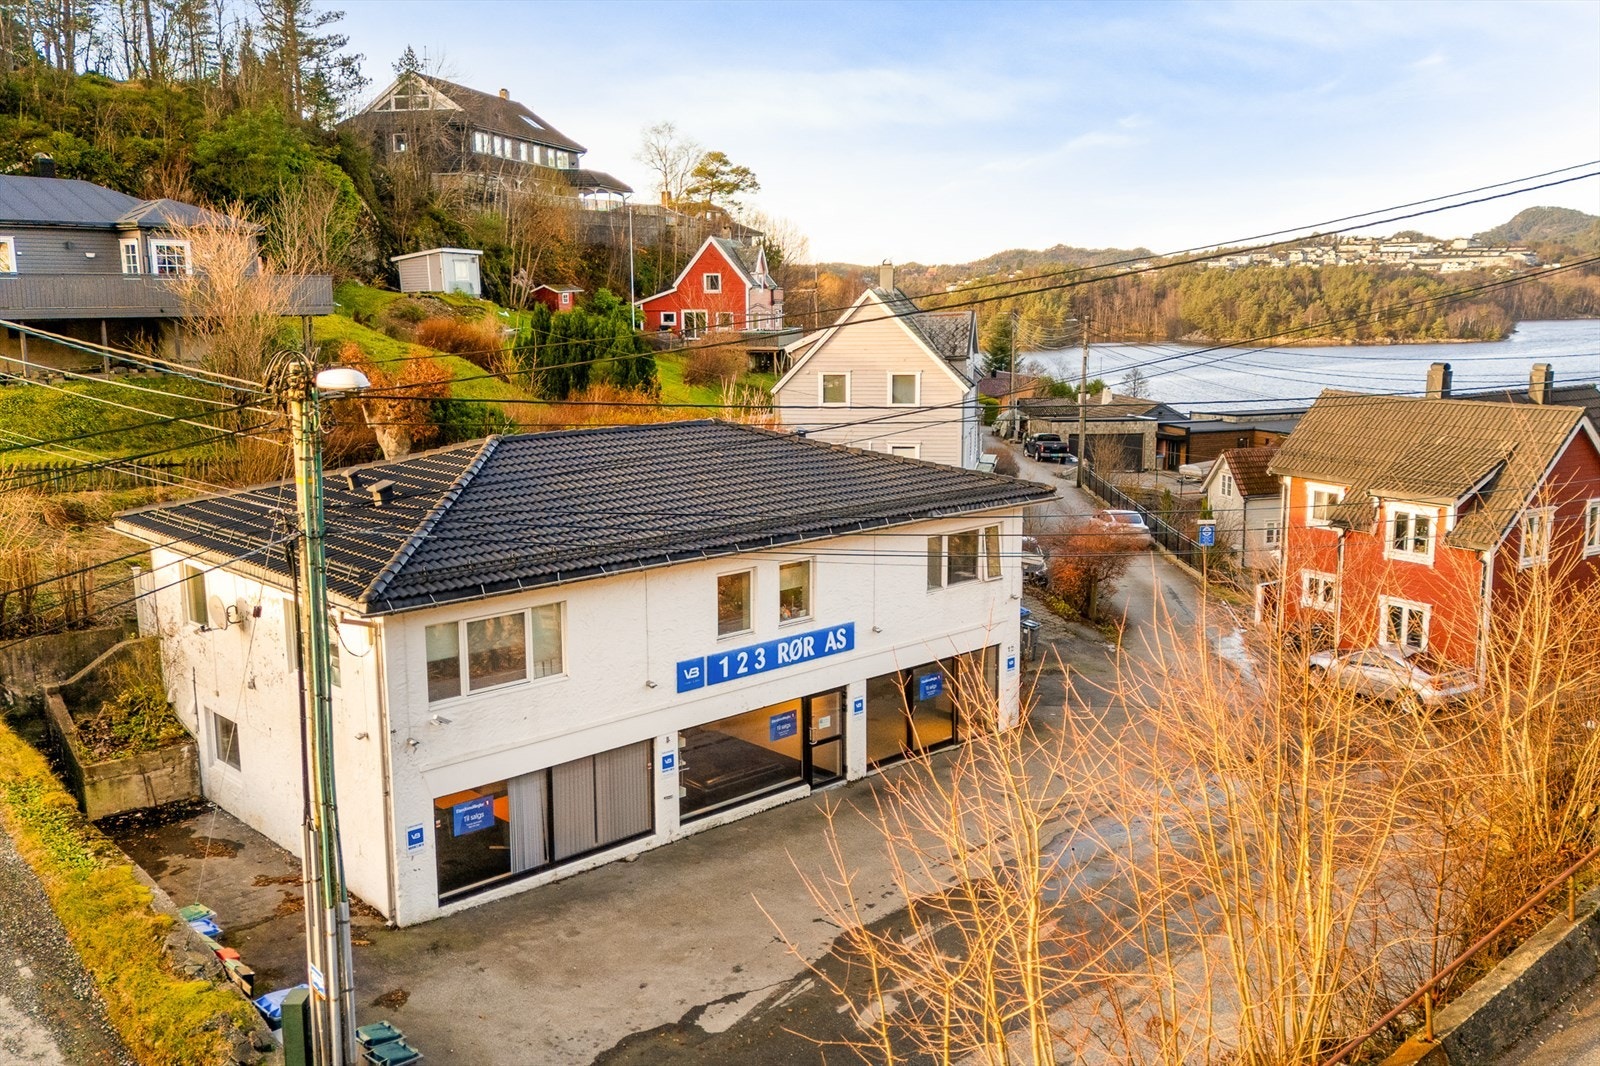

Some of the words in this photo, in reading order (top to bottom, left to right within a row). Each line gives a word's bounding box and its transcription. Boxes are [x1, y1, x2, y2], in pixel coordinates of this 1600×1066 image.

[777, 636, 815, 664] RØR
[824, 628, 847, 652] AS
[684, 667, 700, 679] VB
[470, 812, 484, 820] salgs
